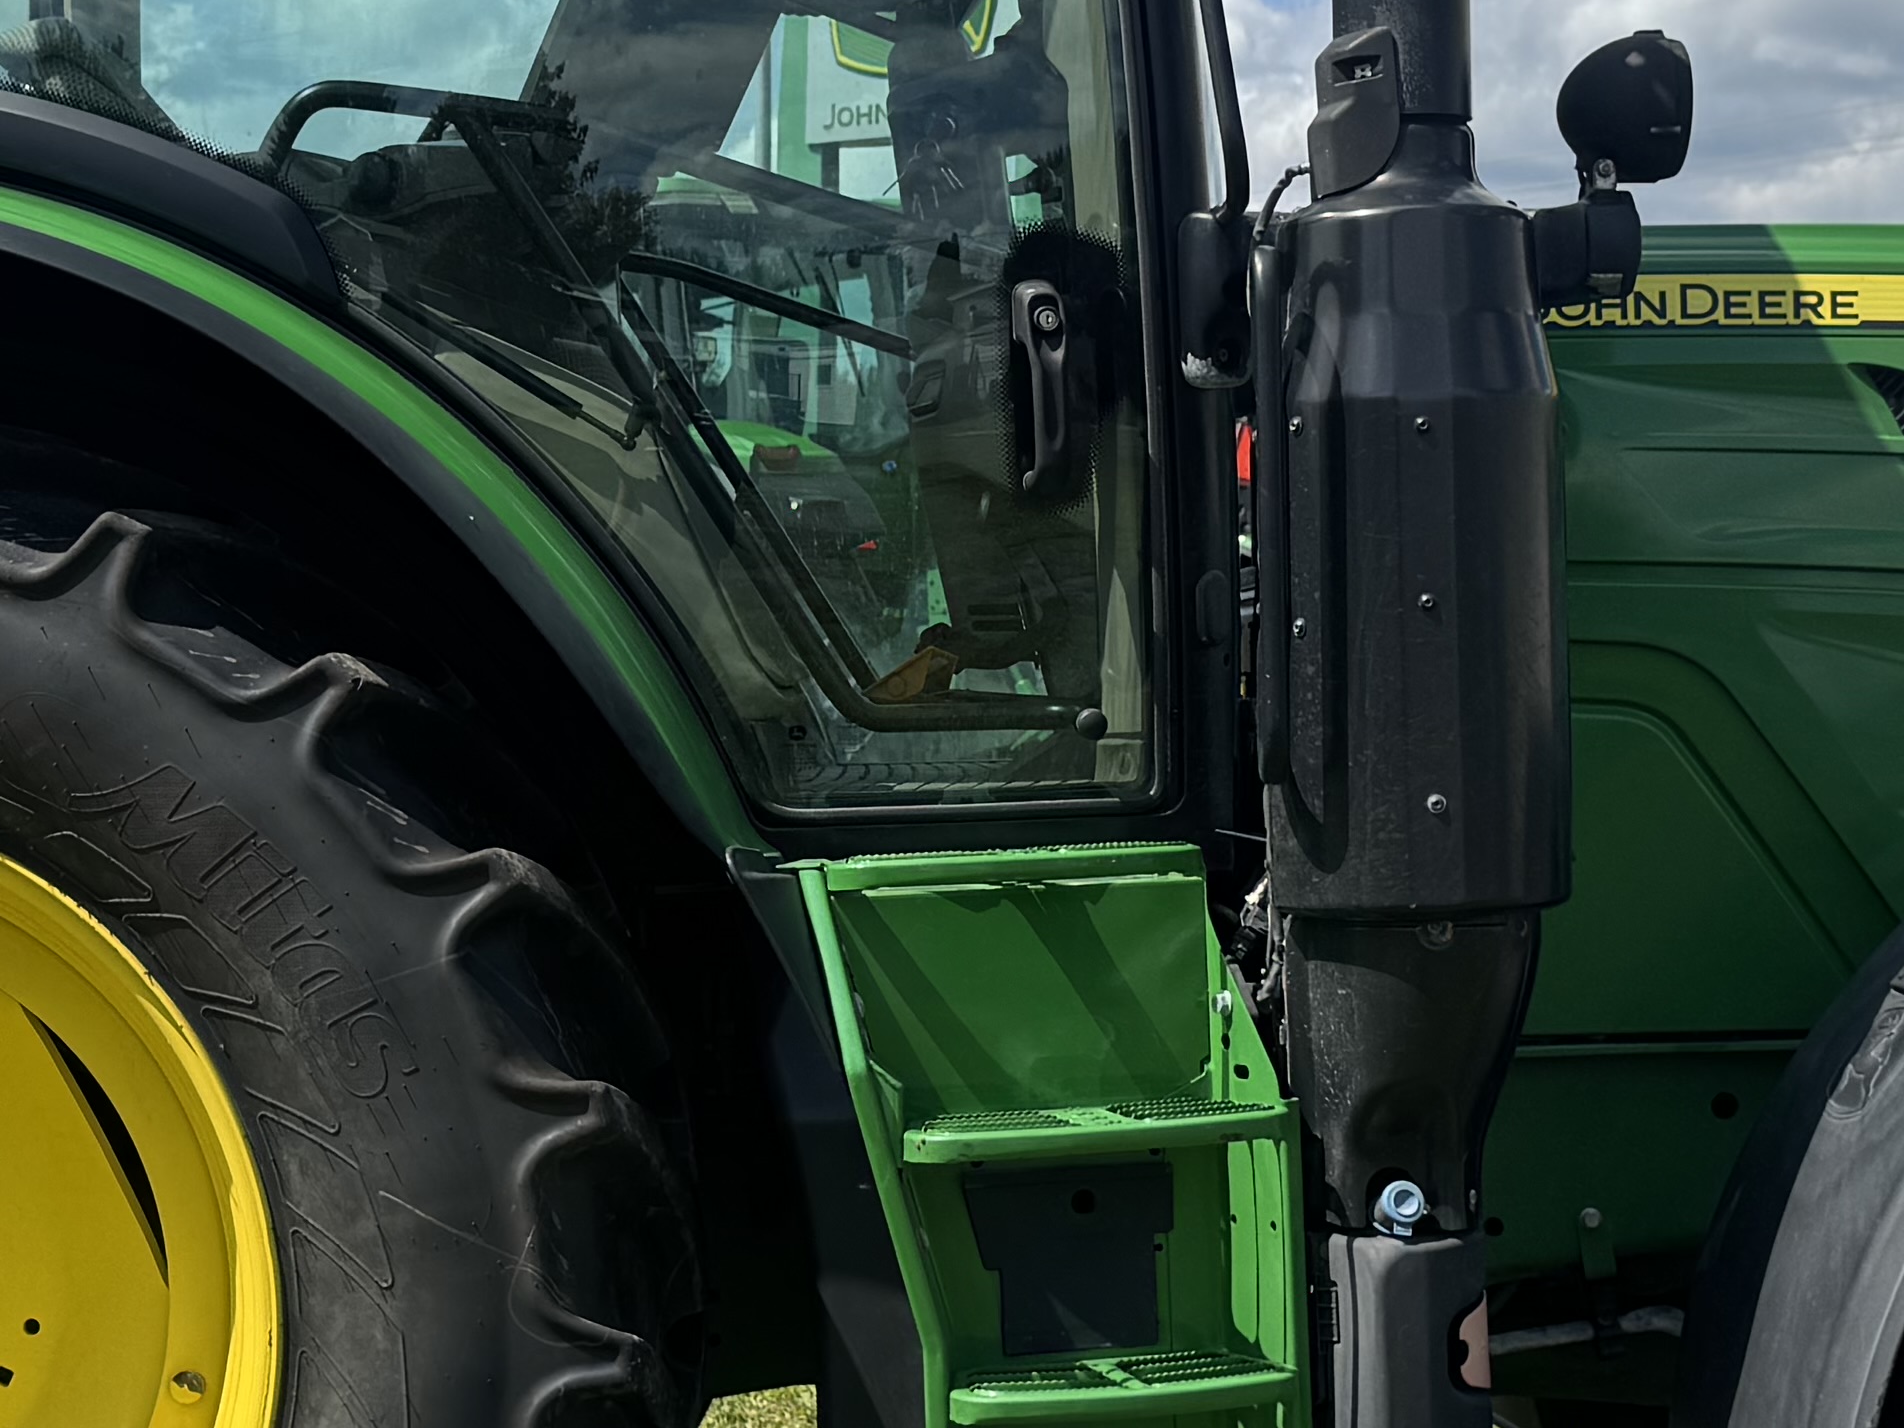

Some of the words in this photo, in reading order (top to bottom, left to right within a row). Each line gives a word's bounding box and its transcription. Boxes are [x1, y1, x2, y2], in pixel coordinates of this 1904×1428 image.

[822, 101, 887, 130] JOHN
[1679, 282, 1859, 320] DEERE
[70, 764, 421, 1100] Mitas
